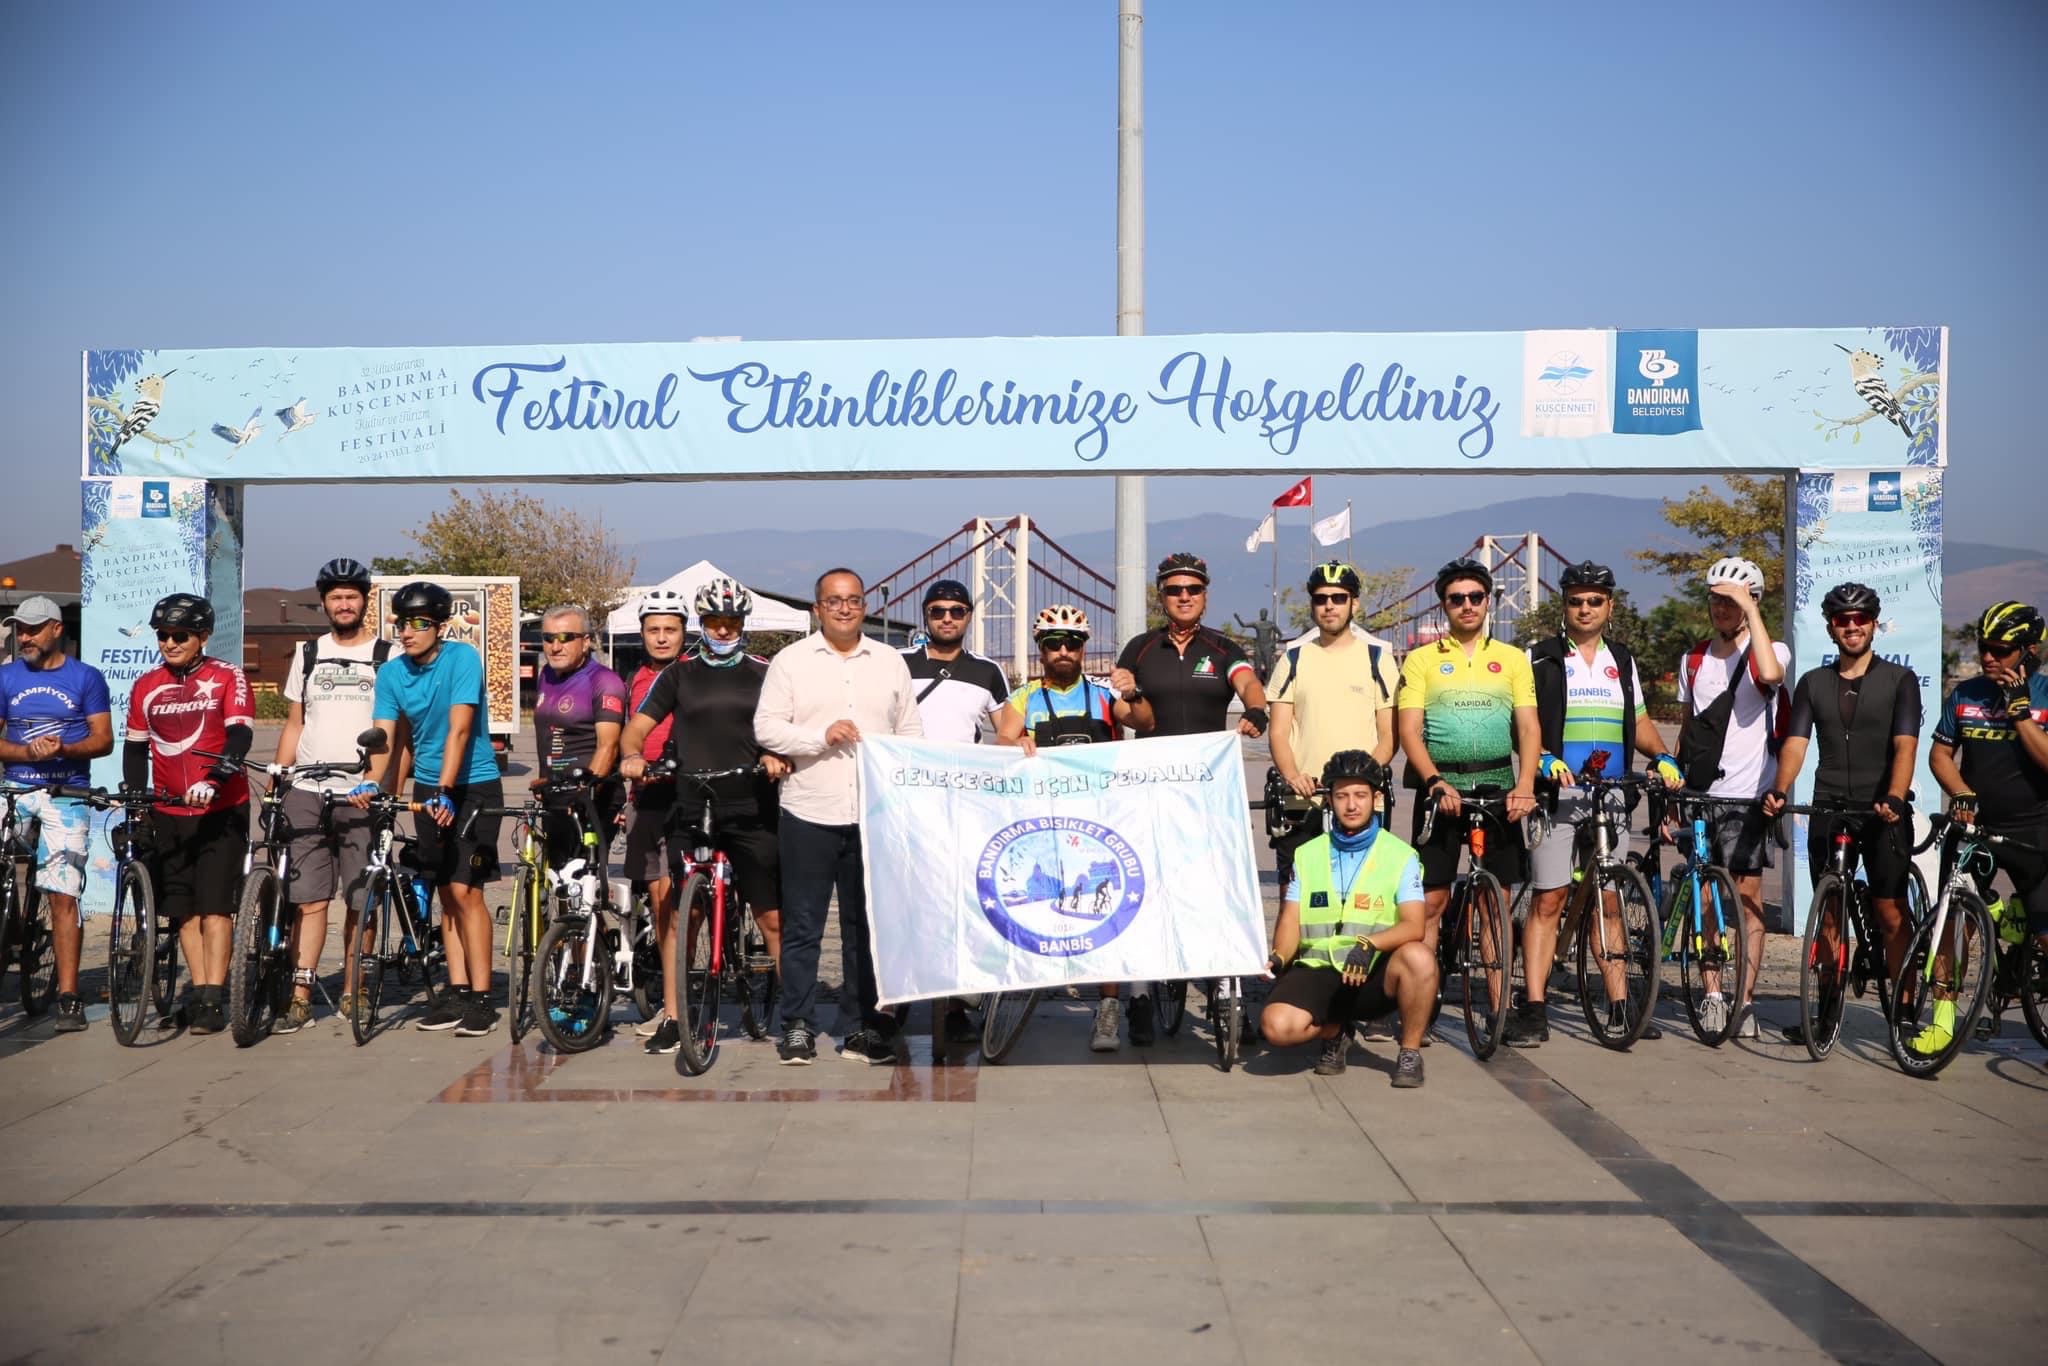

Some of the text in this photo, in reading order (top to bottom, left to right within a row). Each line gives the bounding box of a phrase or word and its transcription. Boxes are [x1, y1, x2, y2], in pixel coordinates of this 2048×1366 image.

[338, 367, 448, 398] BANDIRMA
[327, 380, 458, 417] KUŞCENNETİ
[472, 351, 1500, 461] Festival Etkinliklerimize Hoşgeldiniz
[1627, 388, 1690, 405] BANDIRMA
[1632, 406, 1685, 417] BELEDİYESİ
[340, 420, 446, 452] FESTİVALİ
[103, 549, 179, 567] BANDIRMA
[1823, 544, 1911, 566] BANDIRMA
[1568, 686, 1612, 698] BANBİS
[1961, 727, 2017, 741] SCOT
[890, 762, 1213, 797] GELECEĞİN İÇİN PEDALLA
[979, 820, 1037, 879] BANDIRMA
[1104, 833, 1140, 877] GRUBU
[1039, 935, 1094, 953] BANBİS
